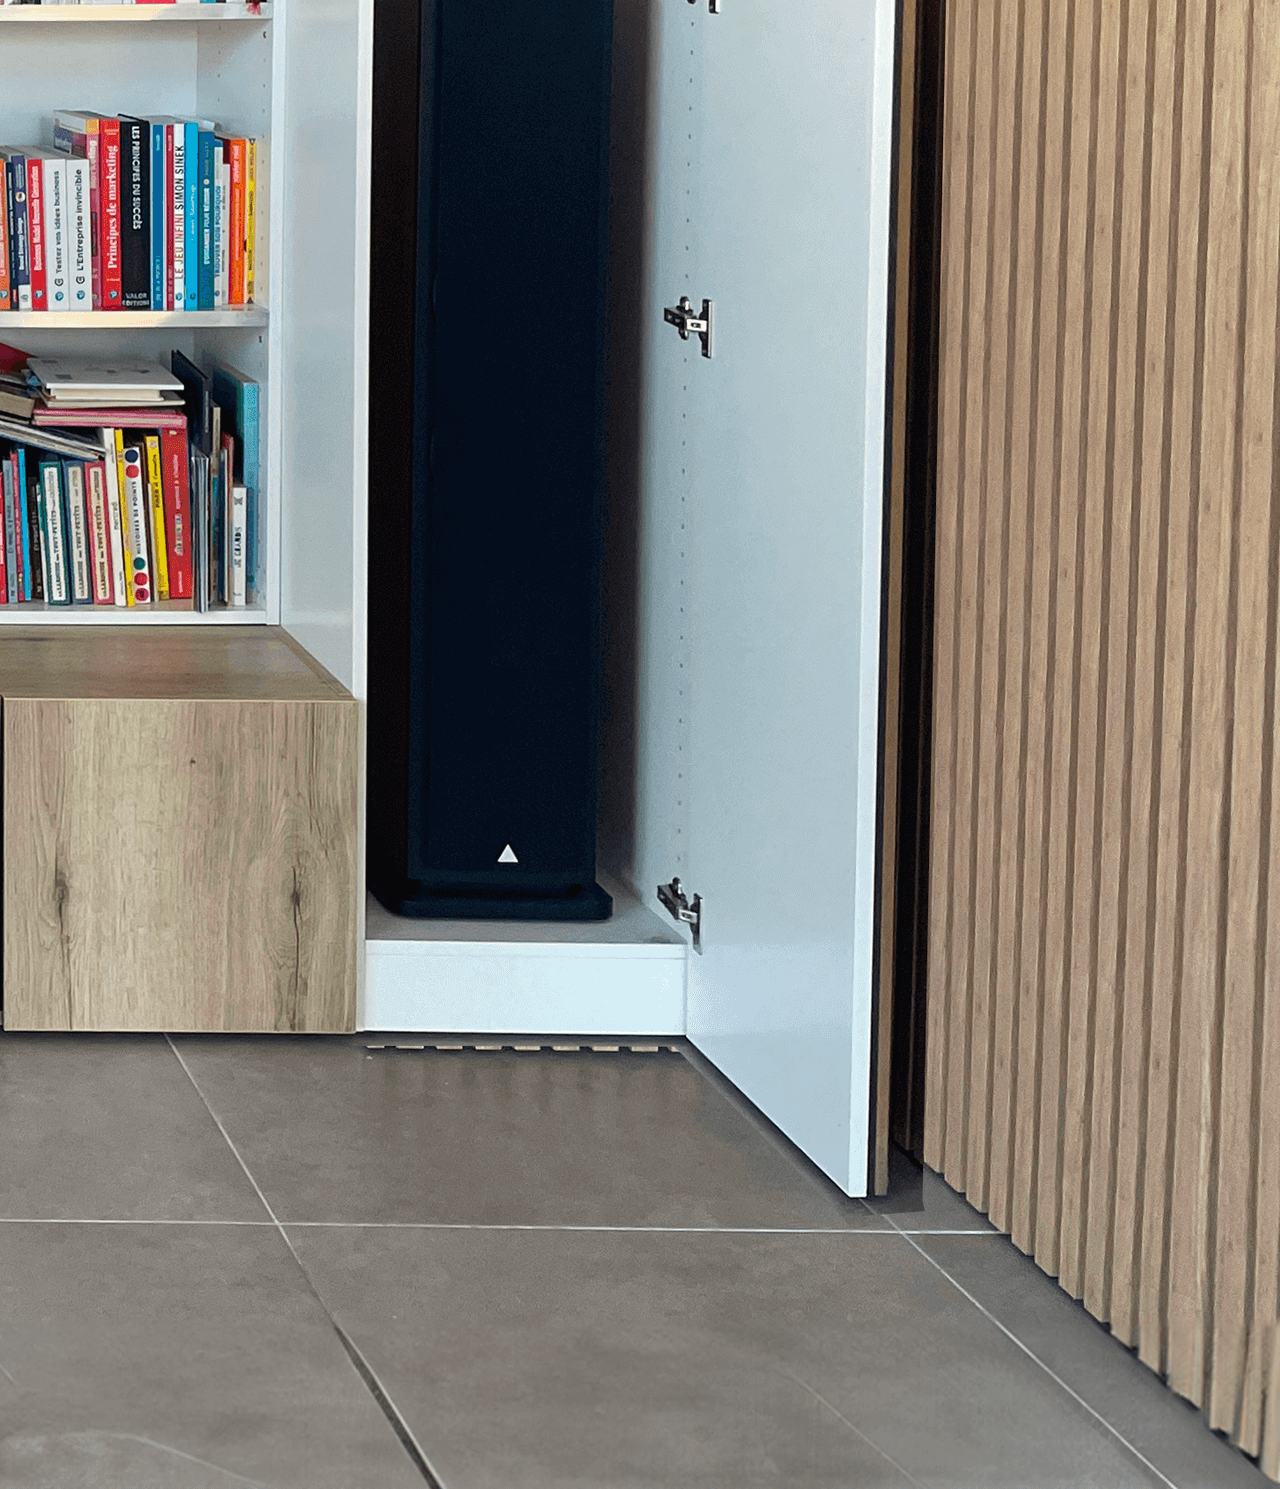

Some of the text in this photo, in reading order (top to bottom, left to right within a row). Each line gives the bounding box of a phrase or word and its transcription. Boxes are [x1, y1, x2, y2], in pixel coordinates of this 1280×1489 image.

[52, 171, 61, 206] business
[131, 125, 142, 229] LES PRINCIPES DU SUCCÈS
[53, 208, 61, 230] idées
[74, 169, 85, 271] L'Entreprise invincible
[105, 145, 118, 269] Principes de marketing
[174, 145, 184, 280] LE JEU INFINI SIMON SINEK
[54, 248, 63, 274] Testez
[133, 508, 139, 517] DE
[134, 519, 142, 555] HISTOIRES
